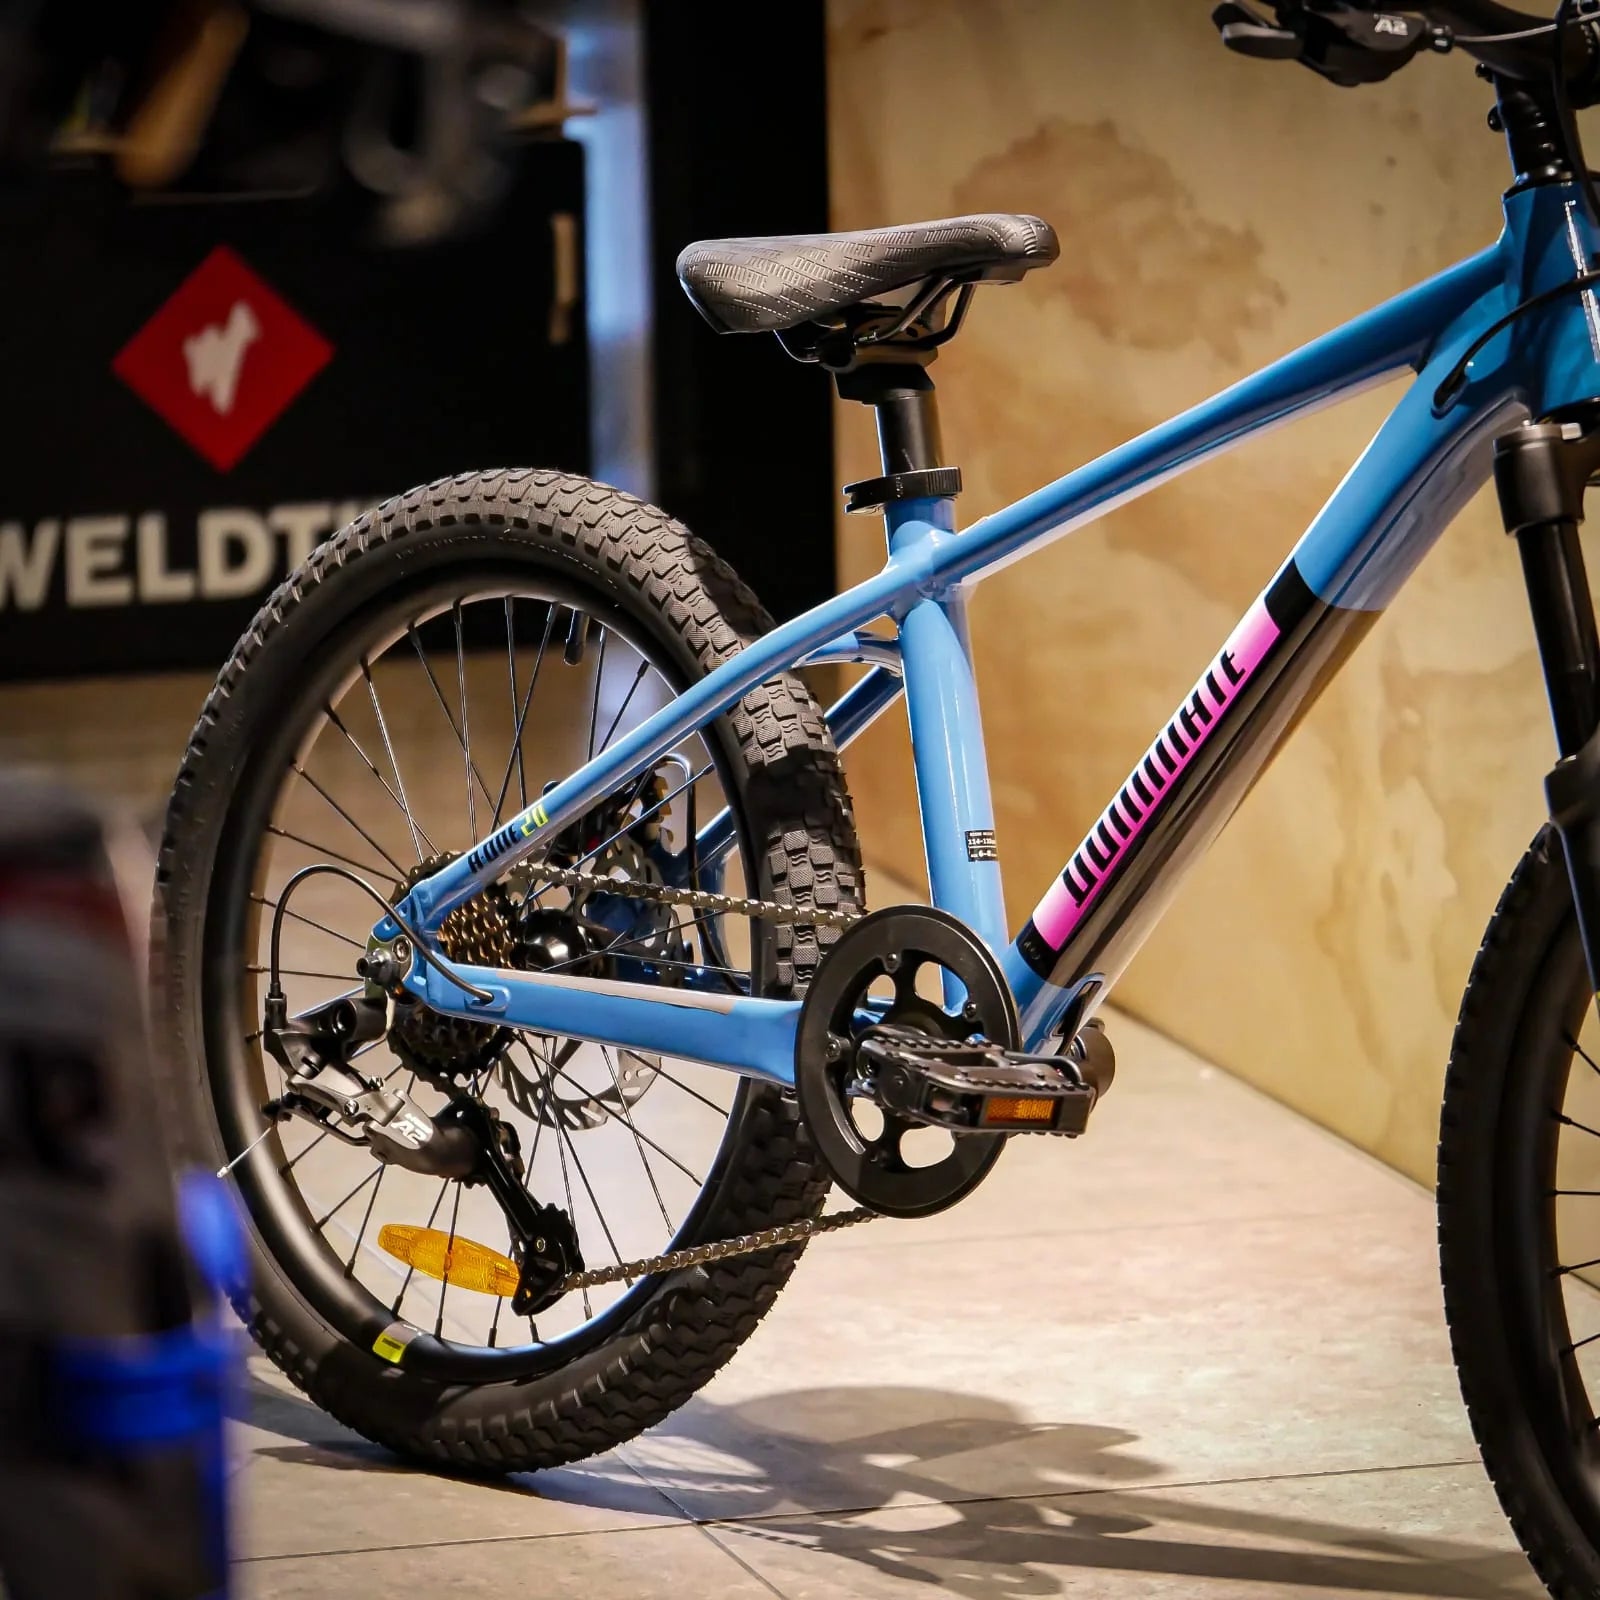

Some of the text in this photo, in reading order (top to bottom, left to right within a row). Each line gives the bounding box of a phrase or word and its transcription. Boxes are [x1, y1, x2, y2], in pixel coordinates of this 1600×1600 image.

[0, 502, 372, 612] WELDT
[521, 804, 549, 837] 20
[390, 1119, 427, 1145] A2
